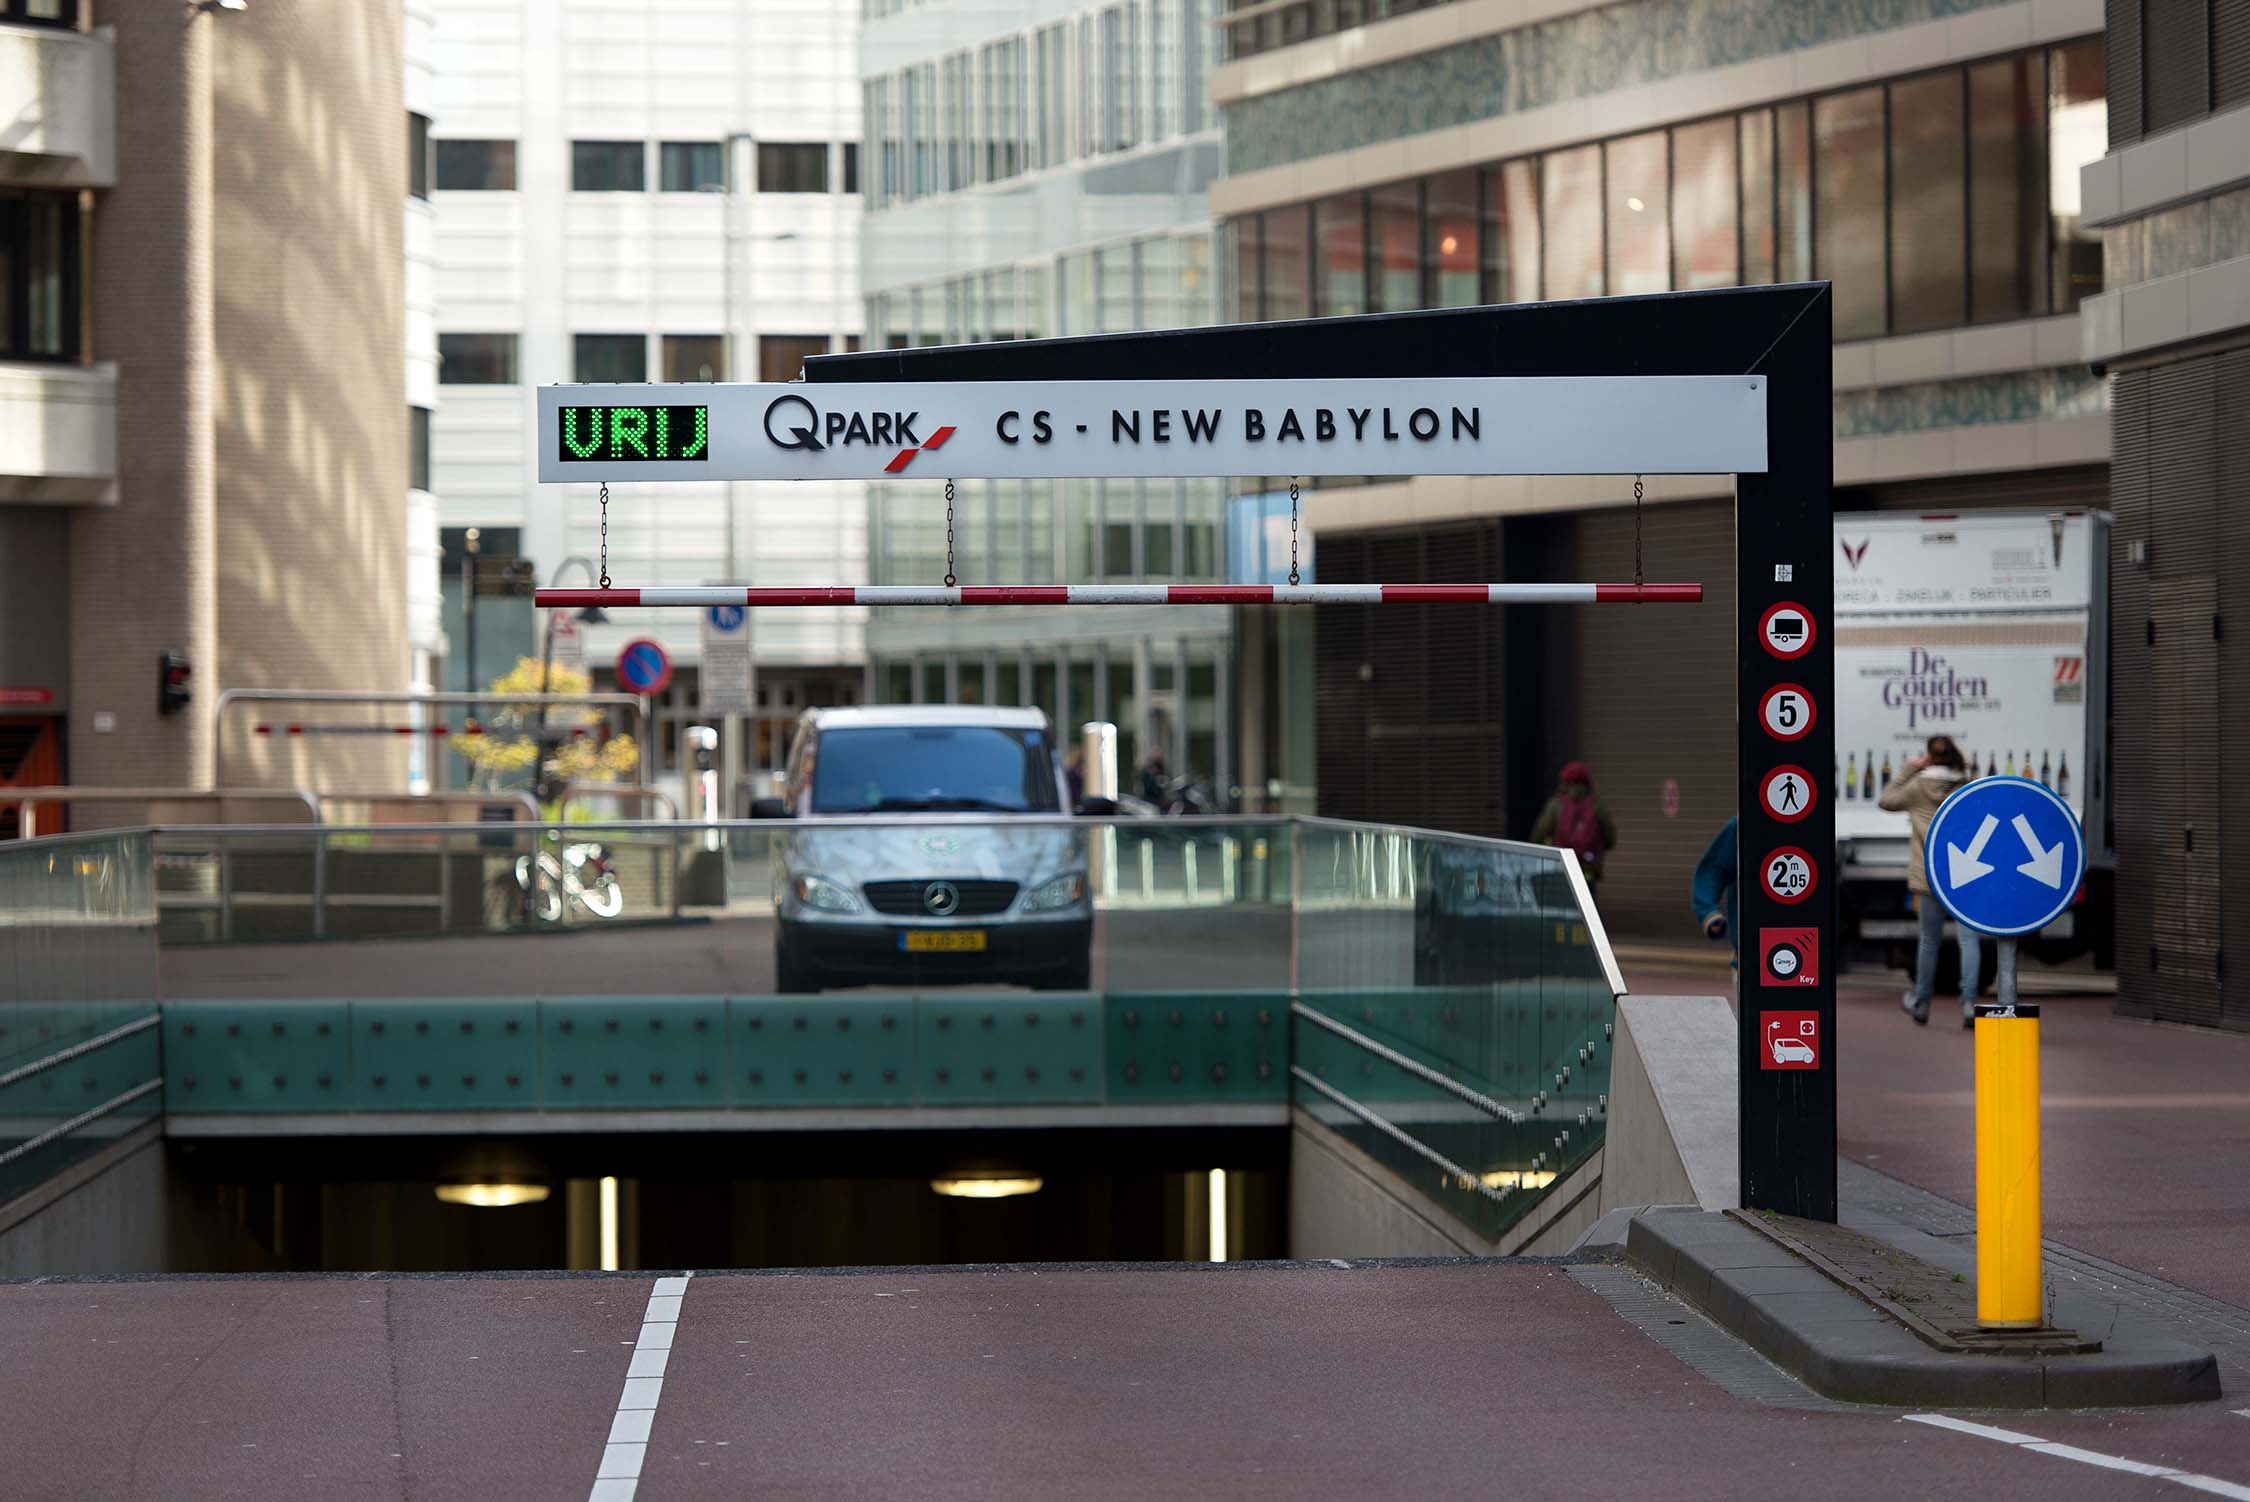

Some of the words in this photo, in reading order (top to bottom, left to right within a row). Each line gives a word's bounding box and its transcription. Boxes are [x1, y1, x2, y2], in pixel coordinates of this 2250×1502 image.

[564, 407, 707, 458] VRIJ
[996, 410, 1053, 444] CS
[1112, 408, 1222, 442] NEW
[1245, 406, 1481, 441] BABYLON
[1910, 647, 1946, 676] De
[1883, 666, 1988, 709] Gouden
[1778, 695, 1797, 728] 5
[1903, 698, 1956, 728] Ton
[1799, 975, 1815, 985] Key
